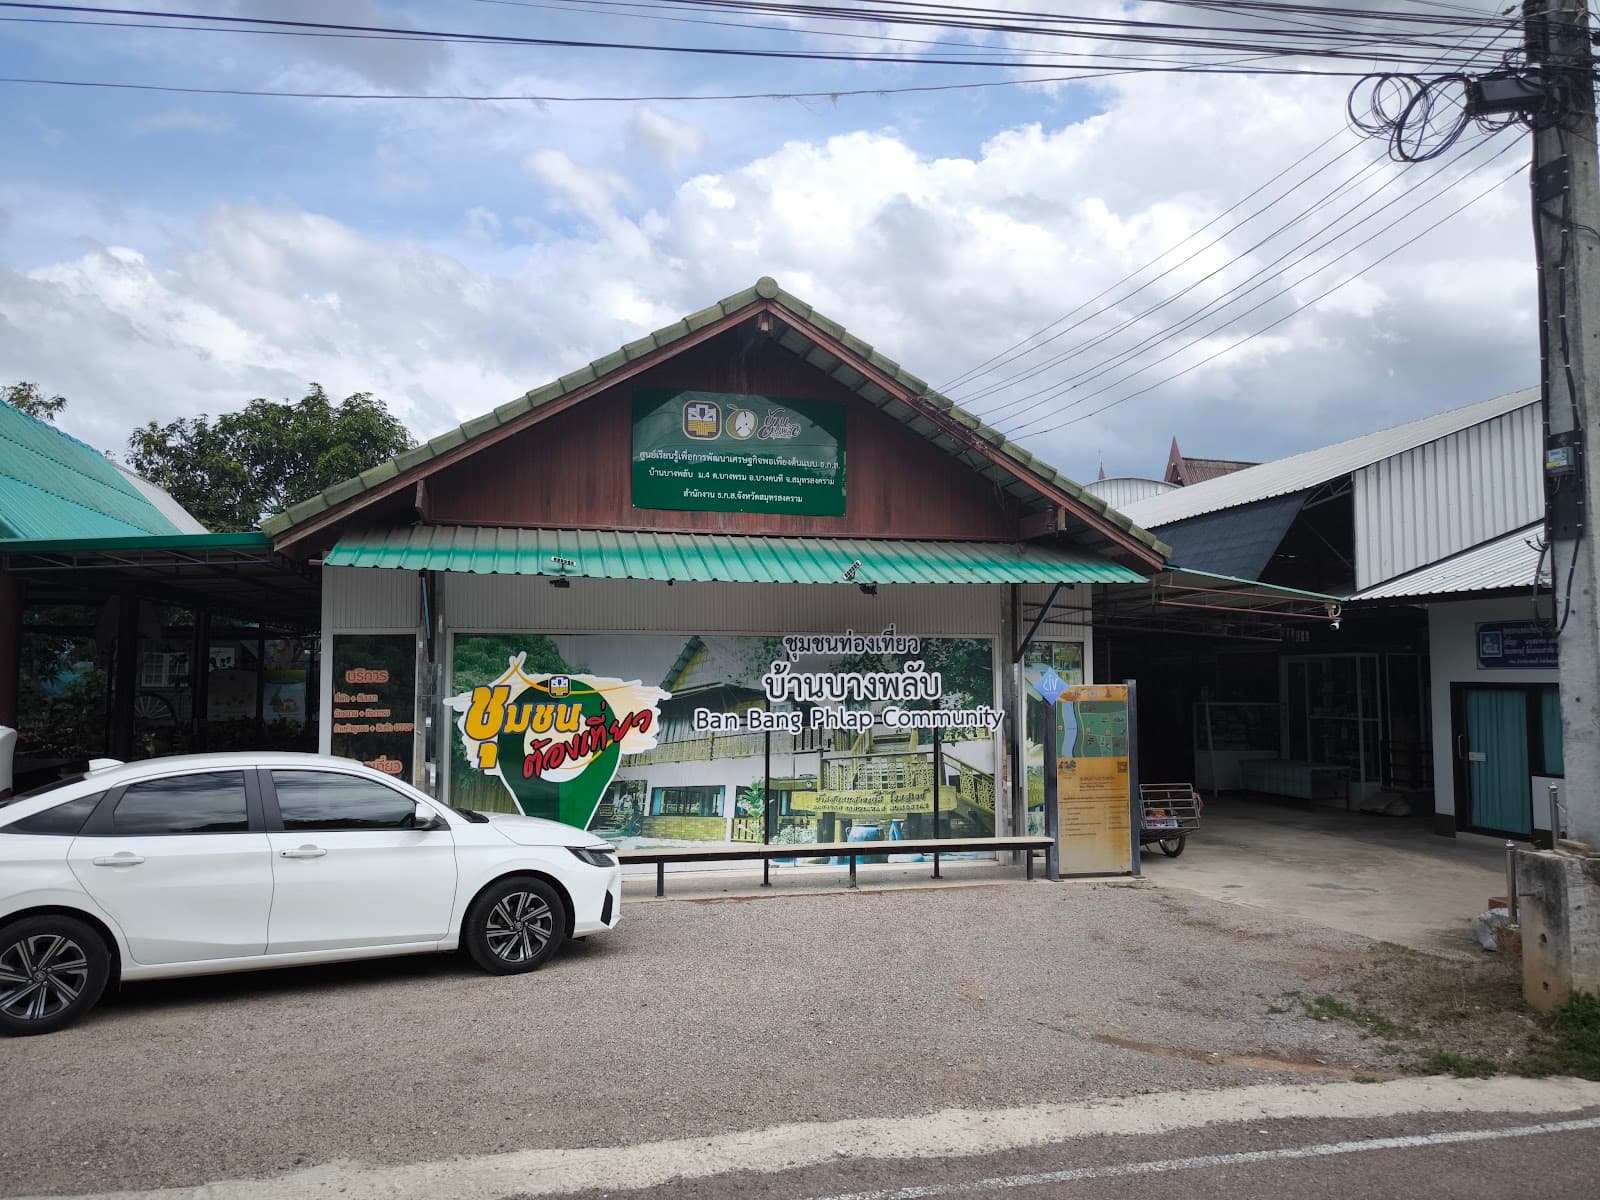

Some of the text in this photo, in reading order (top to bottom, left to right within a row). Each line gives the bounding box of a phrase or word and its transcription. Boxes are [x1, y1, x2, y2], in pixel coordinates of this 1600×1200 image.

[649, 467, 693, 478] บ้านบางพลับ
[683, 488, 715, 498] สำนักงาน
[785, 625, 920, 660] ชุมชนท่องเที่ยว
[764, 663, 941, 699] บ้านบางพลับ
[465, 685, 582, 769] ชุมชน
[696, 707, 1004, 731] Ban Bang Phlap Community
[523, 701, 653, 779] ต้องเที่ยว
